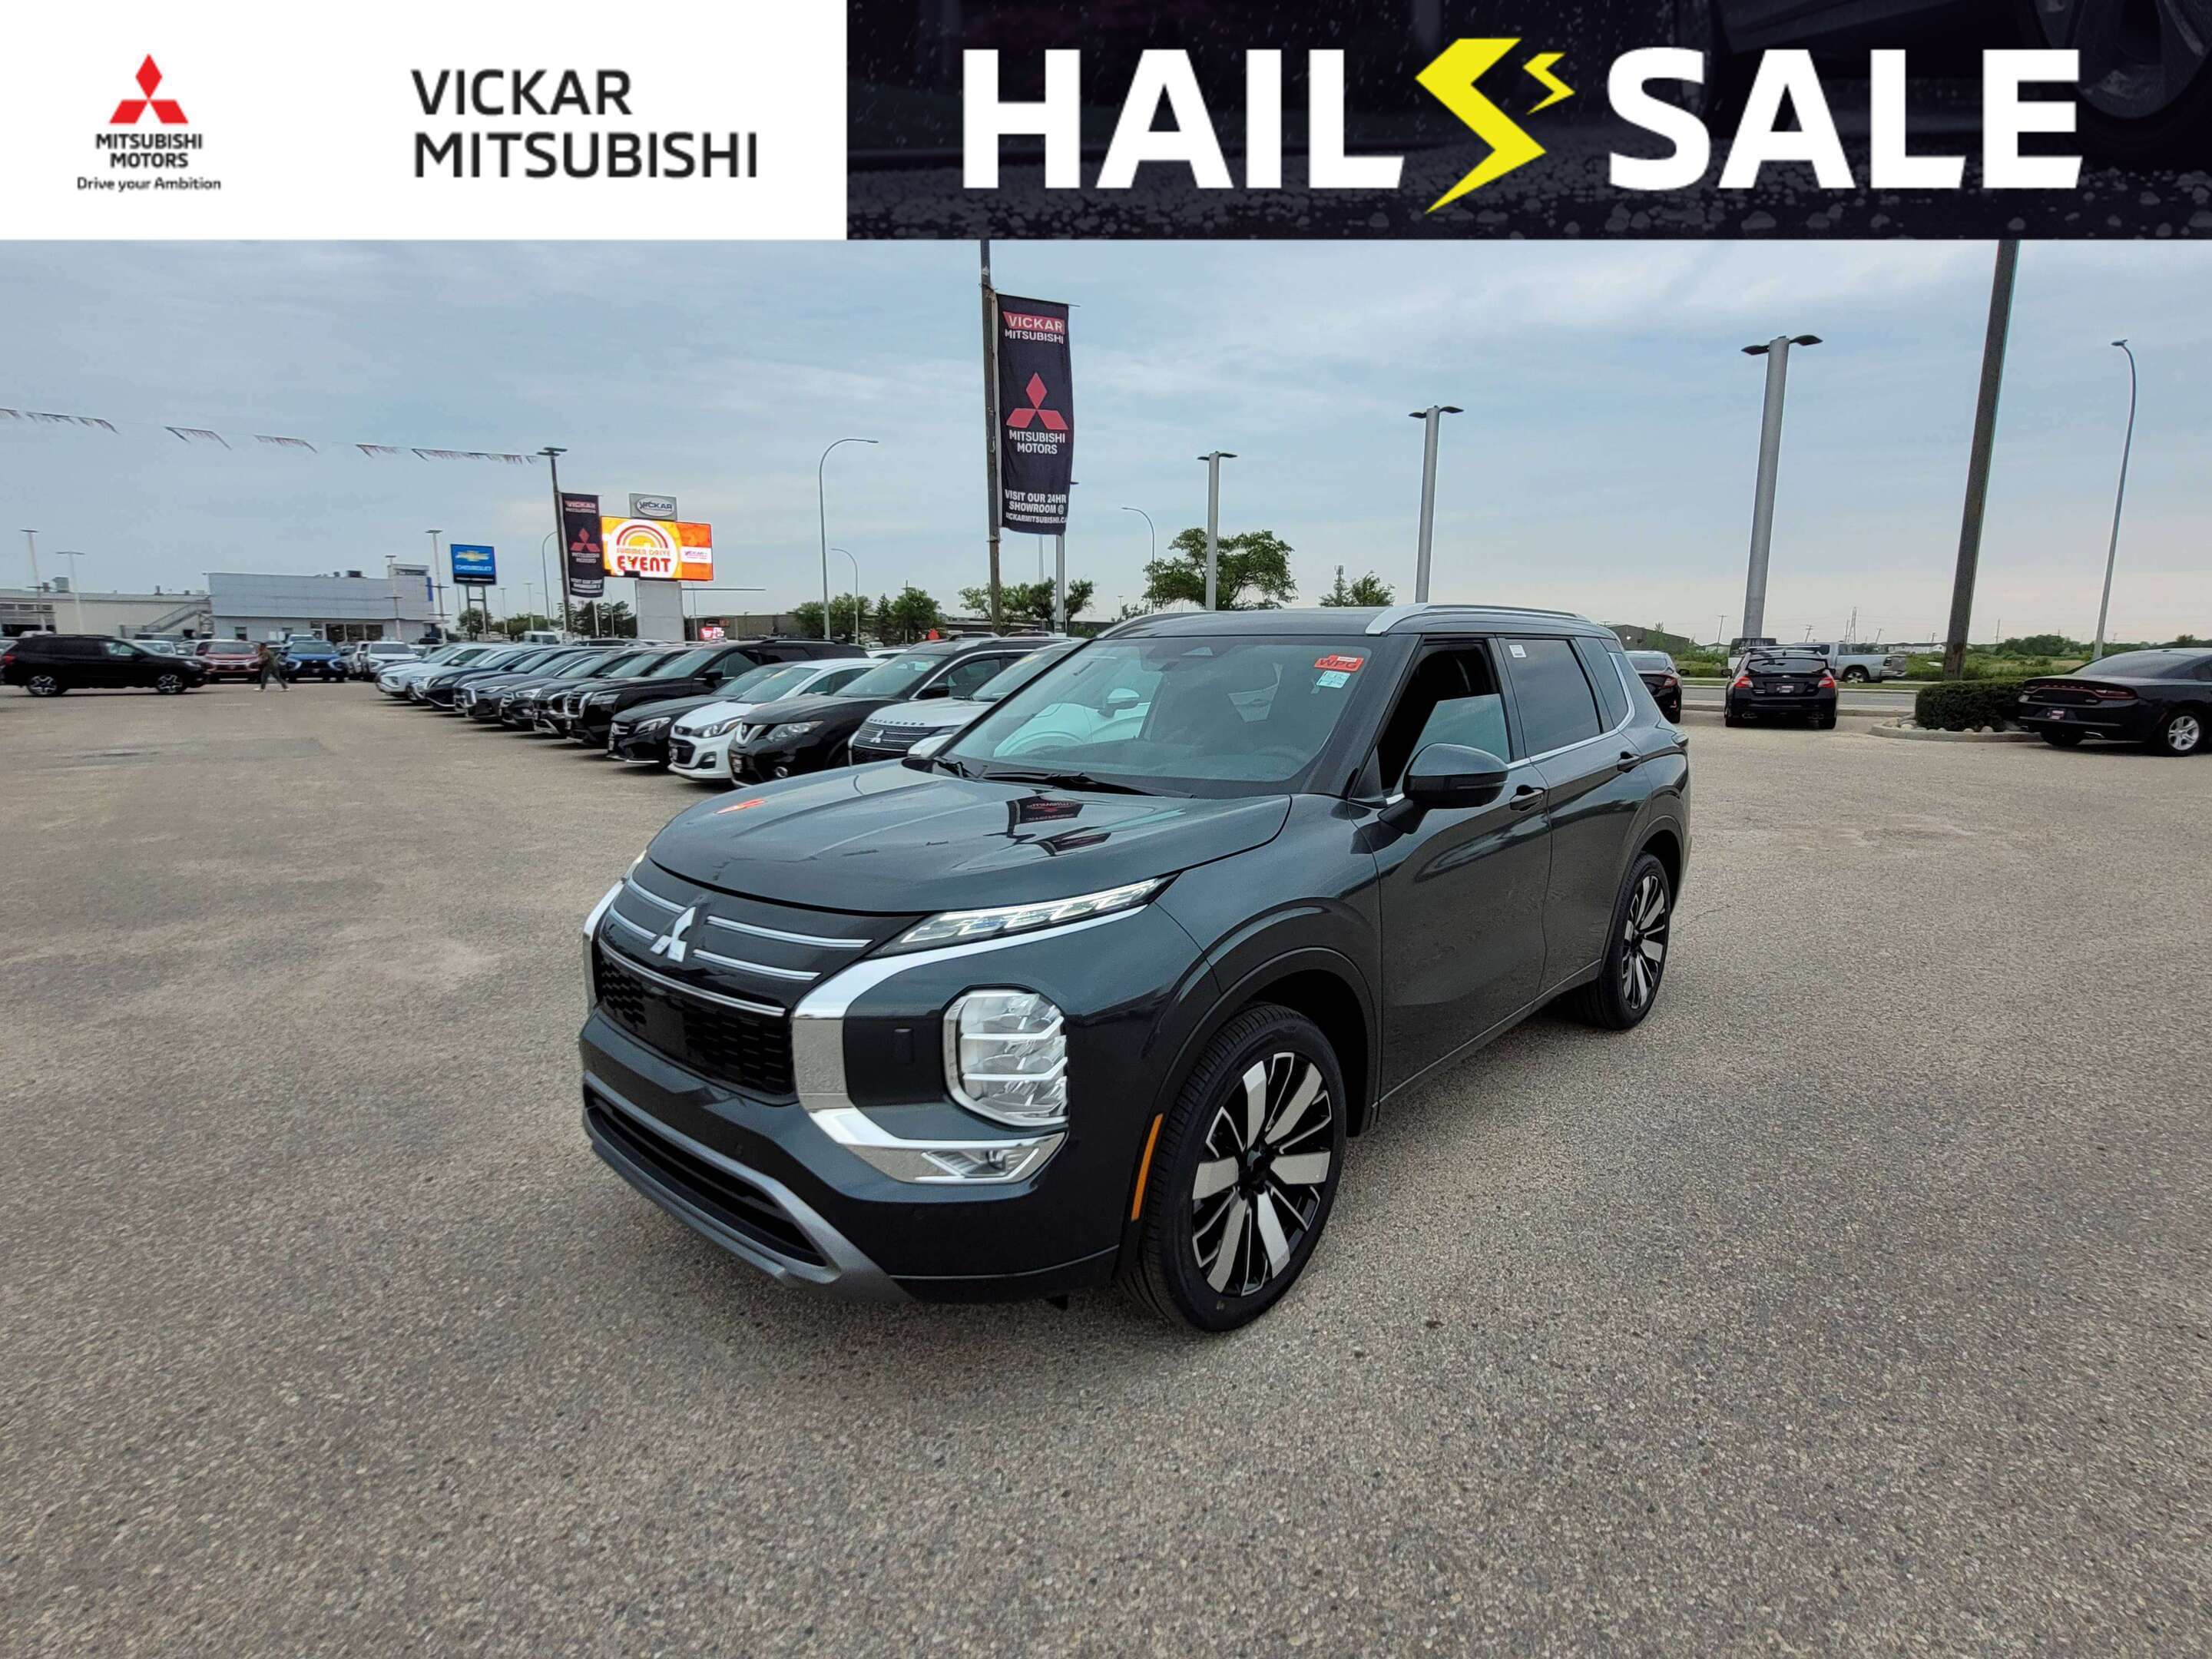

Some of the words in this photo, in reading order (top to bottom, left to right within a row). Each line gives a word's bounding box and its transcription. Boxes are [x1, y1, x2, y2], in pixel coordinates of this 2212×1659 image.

[1008, 315, 1064, 333] VICKAR
[1005, 328, 1064, 345] MITSUBISHI
[1008, 429, 1065, 443] MITSUBISHI
[1017, 442, 1058, 455] MOTORS
[1005, 488, 1026, 502] VISIT
[1027, 492, 1046, 504] OUR
[1047, 493, 1067, 504] 24HR
[1008, 500, 1057, 514] SHOWROOM
[617, 555, 671, 572] EVENT
